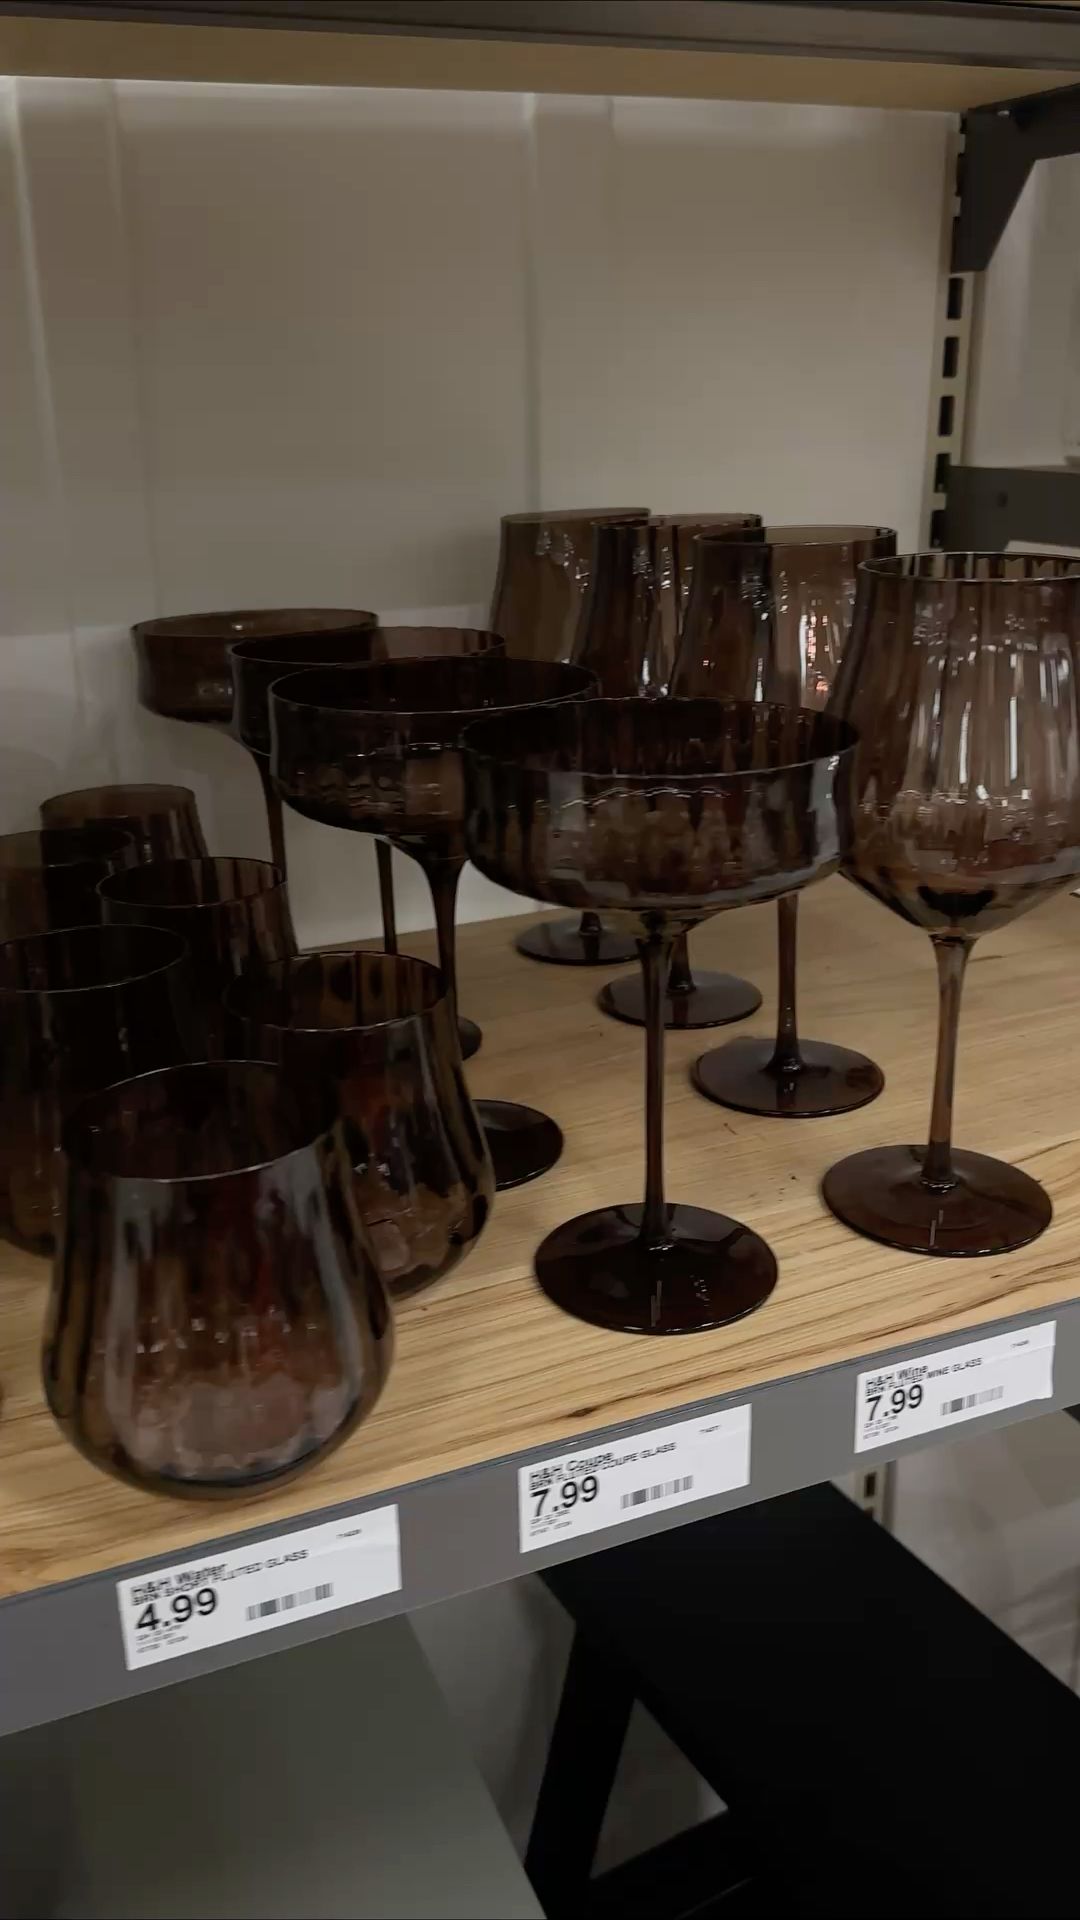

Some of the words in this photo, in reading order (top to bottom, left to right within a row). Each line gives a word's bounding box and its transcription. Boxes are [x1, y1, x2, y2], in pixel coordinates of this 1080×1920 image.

[897, 1365, 929, 1380] Wine
[951, 1357, 982, 1373] GLASS
[866, 1384, 923, 1422] 7.99
[566, 1451, 614, 1472] Coupe
[601, 1453, 638, 1471] COUPE
[640, 1441, 677, 1459] GLASS
[530, 1475, 599, 1517] 7.99
[265, 1549, 310, 1569] GLASS
[175, 1563, 227, 1585] Water
[135, 1587, 218, 1631] 4.99
